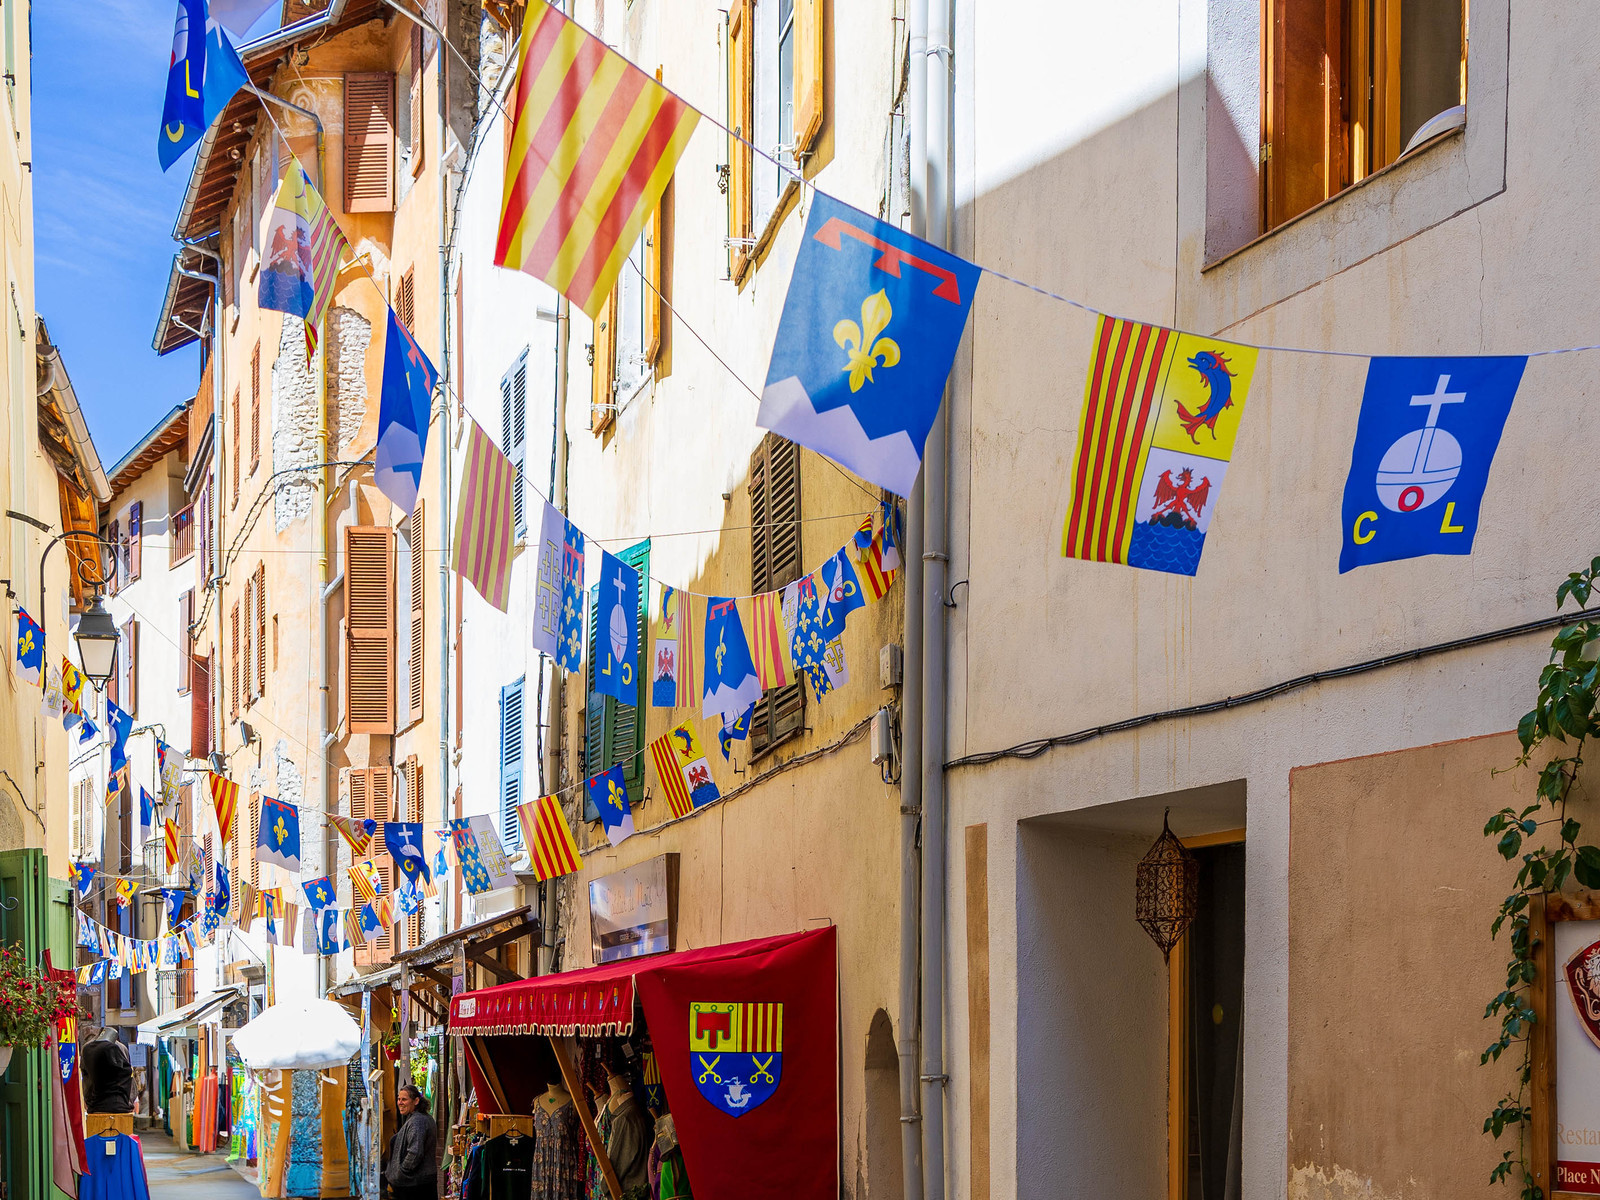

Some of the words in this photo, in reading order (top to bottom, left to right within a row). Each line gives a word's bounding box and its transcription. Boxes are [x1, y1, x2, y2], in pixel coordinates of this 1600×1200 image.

[1353, 510, 1378, 545] C
[1398, 486, 1424, 512] O
[1440, 502, 1464, 534] L
[1557, 1121, 1600, 1146] Resta
[1557, 1166, 1588, 1184] Place
